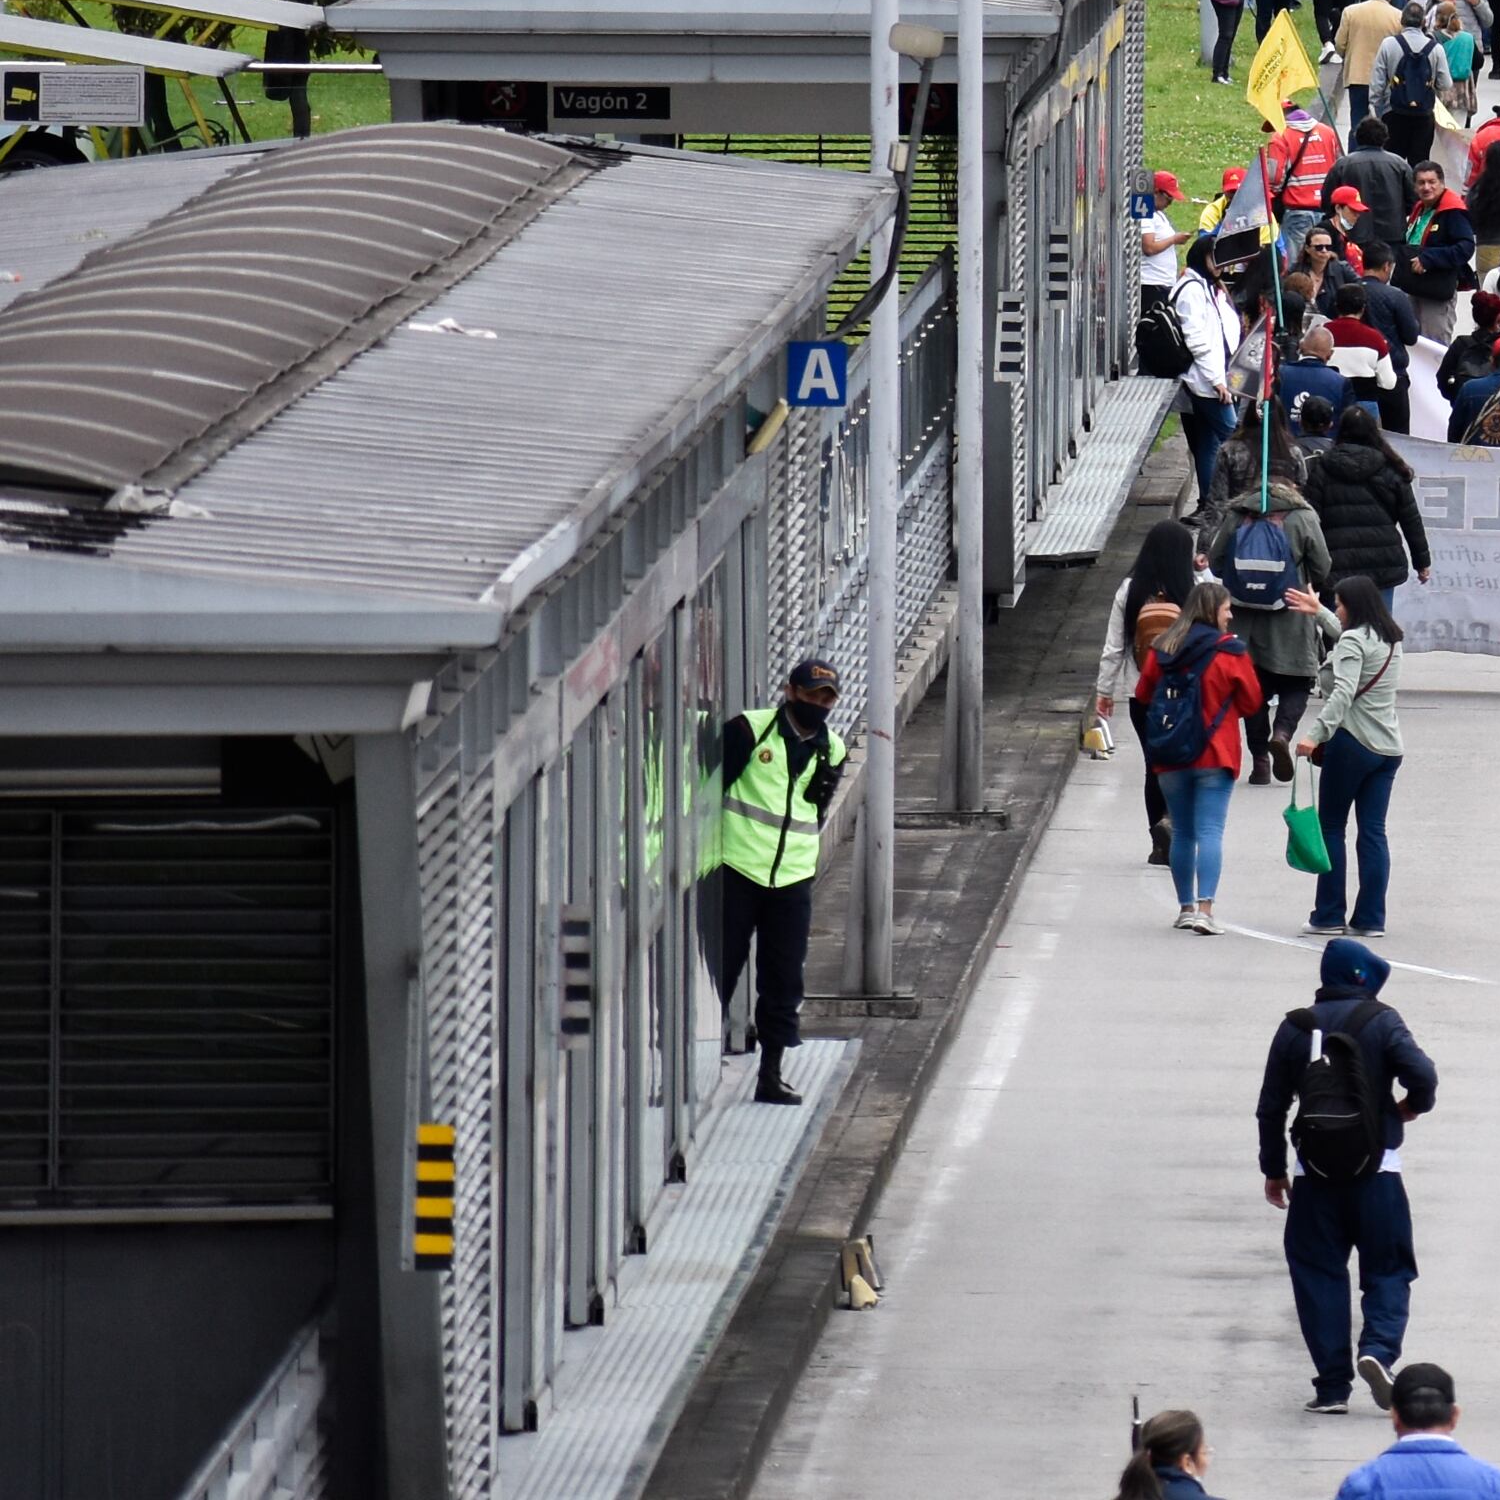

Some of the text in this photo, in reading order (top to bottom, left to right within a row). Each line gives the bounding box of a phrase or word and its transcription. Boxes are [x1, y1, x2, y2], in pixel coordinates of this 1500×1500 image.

[560, 91, 648, 114] Vagón 2
[1135, 171, 1149, 194] 6
[1135, 196, 1149, 217] 4
